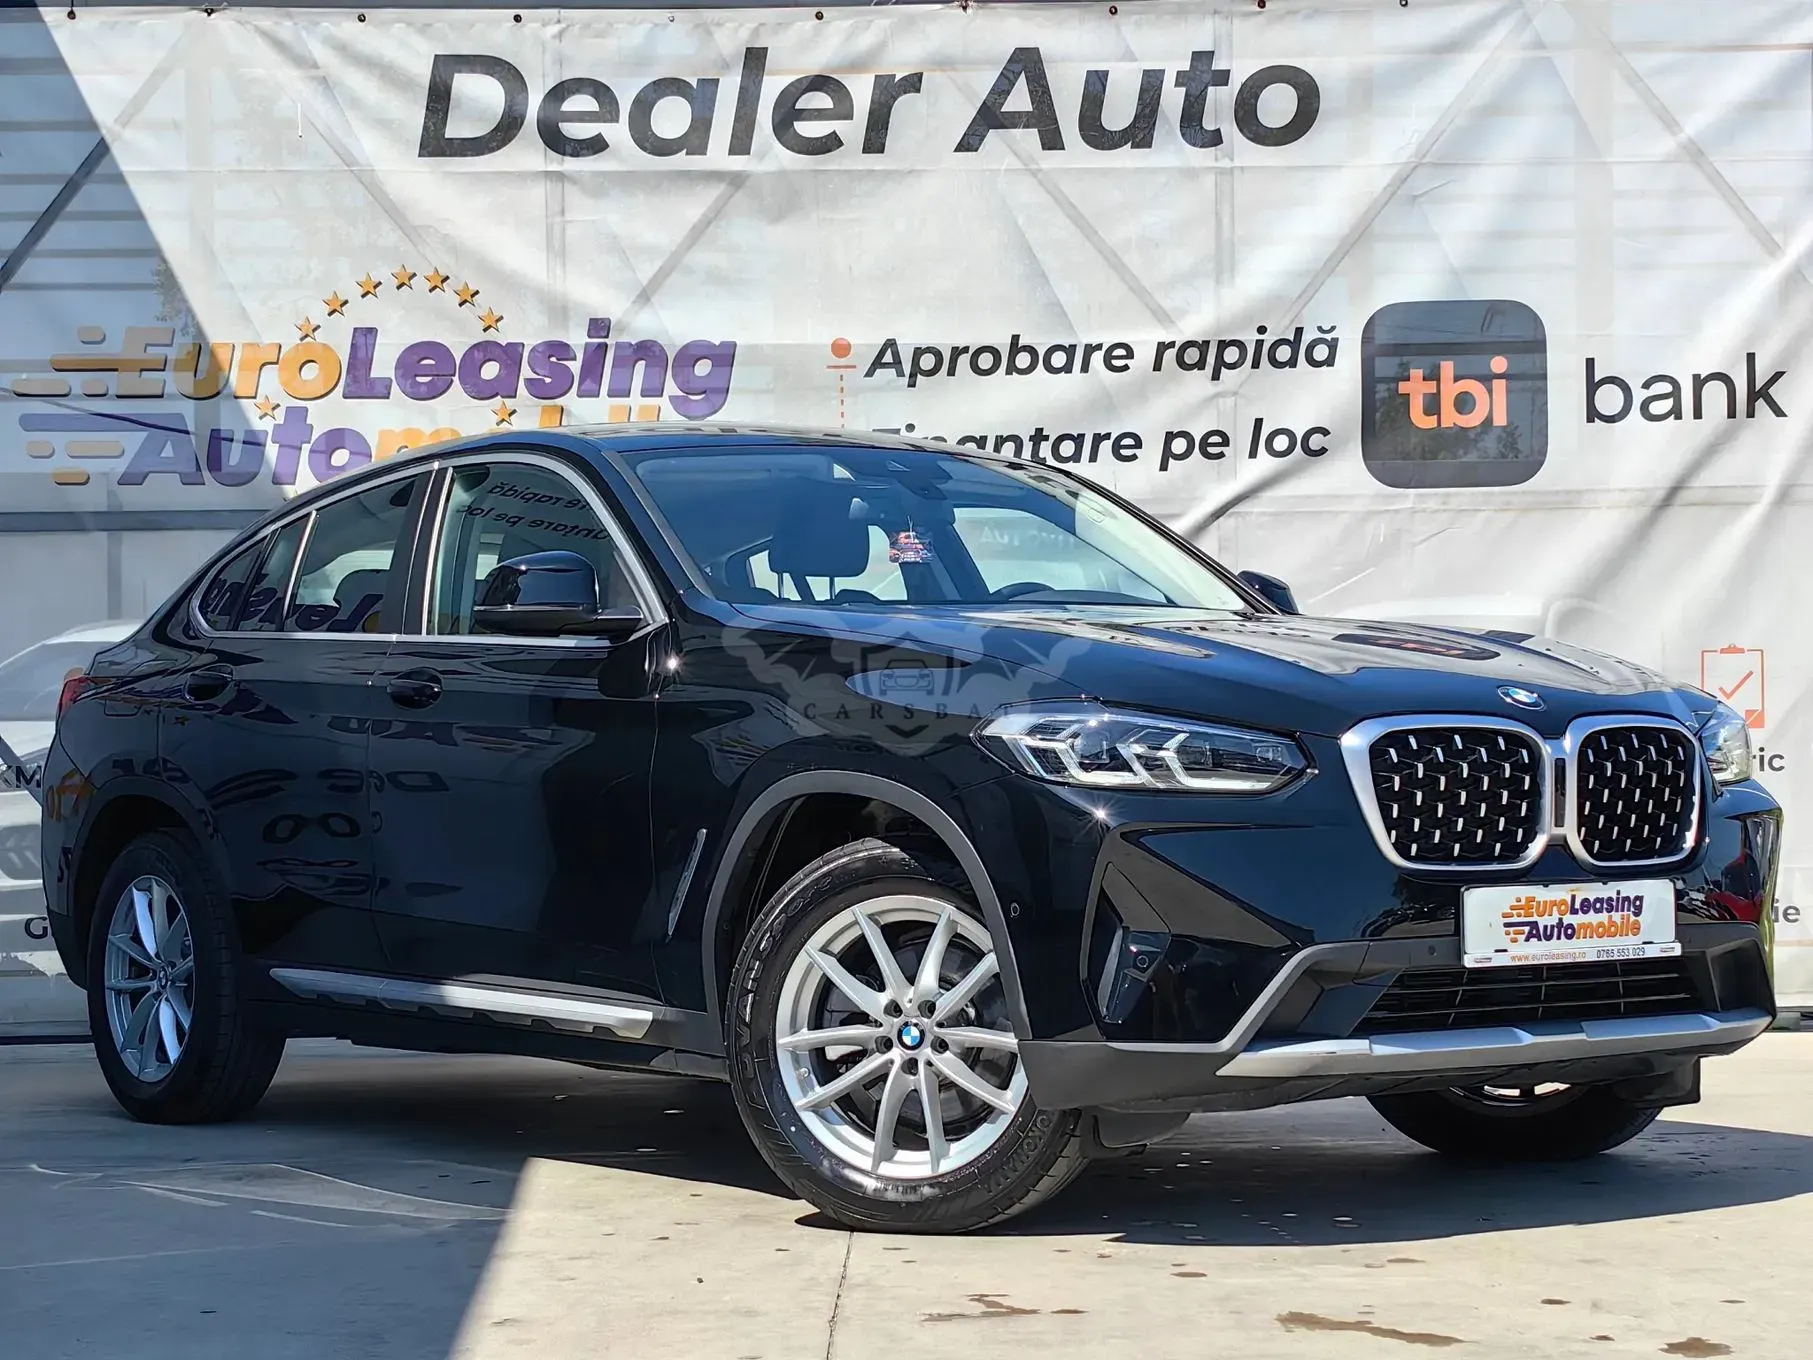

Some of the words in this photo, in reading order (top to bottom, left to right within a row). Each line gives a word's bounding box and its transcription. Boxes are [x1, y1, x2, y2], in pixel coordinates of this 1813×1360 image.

[417, 46, 925, 158] Dealer
[953, 47, 1320, 154] Auto
[114, 317, 736, 420] EuroLeasing
[863, 334, 1136, 387] Aprobare
[1152, 324, 1339, 381] rapidă
[1398, 356, 1508, 430] tbi
[1586, 352, 1788, 424] bank
[872, 422, 1142, 464] ntare
[1159, 428, 1230, 472] pe
[1248, 418, 1332, 459] loc
[1519, 889, 1644, 918] EuroLeasing
[1523, 914, 1642, 943] Automobile
[1510, 950, 1587, 963] www.euroleasing.ro
